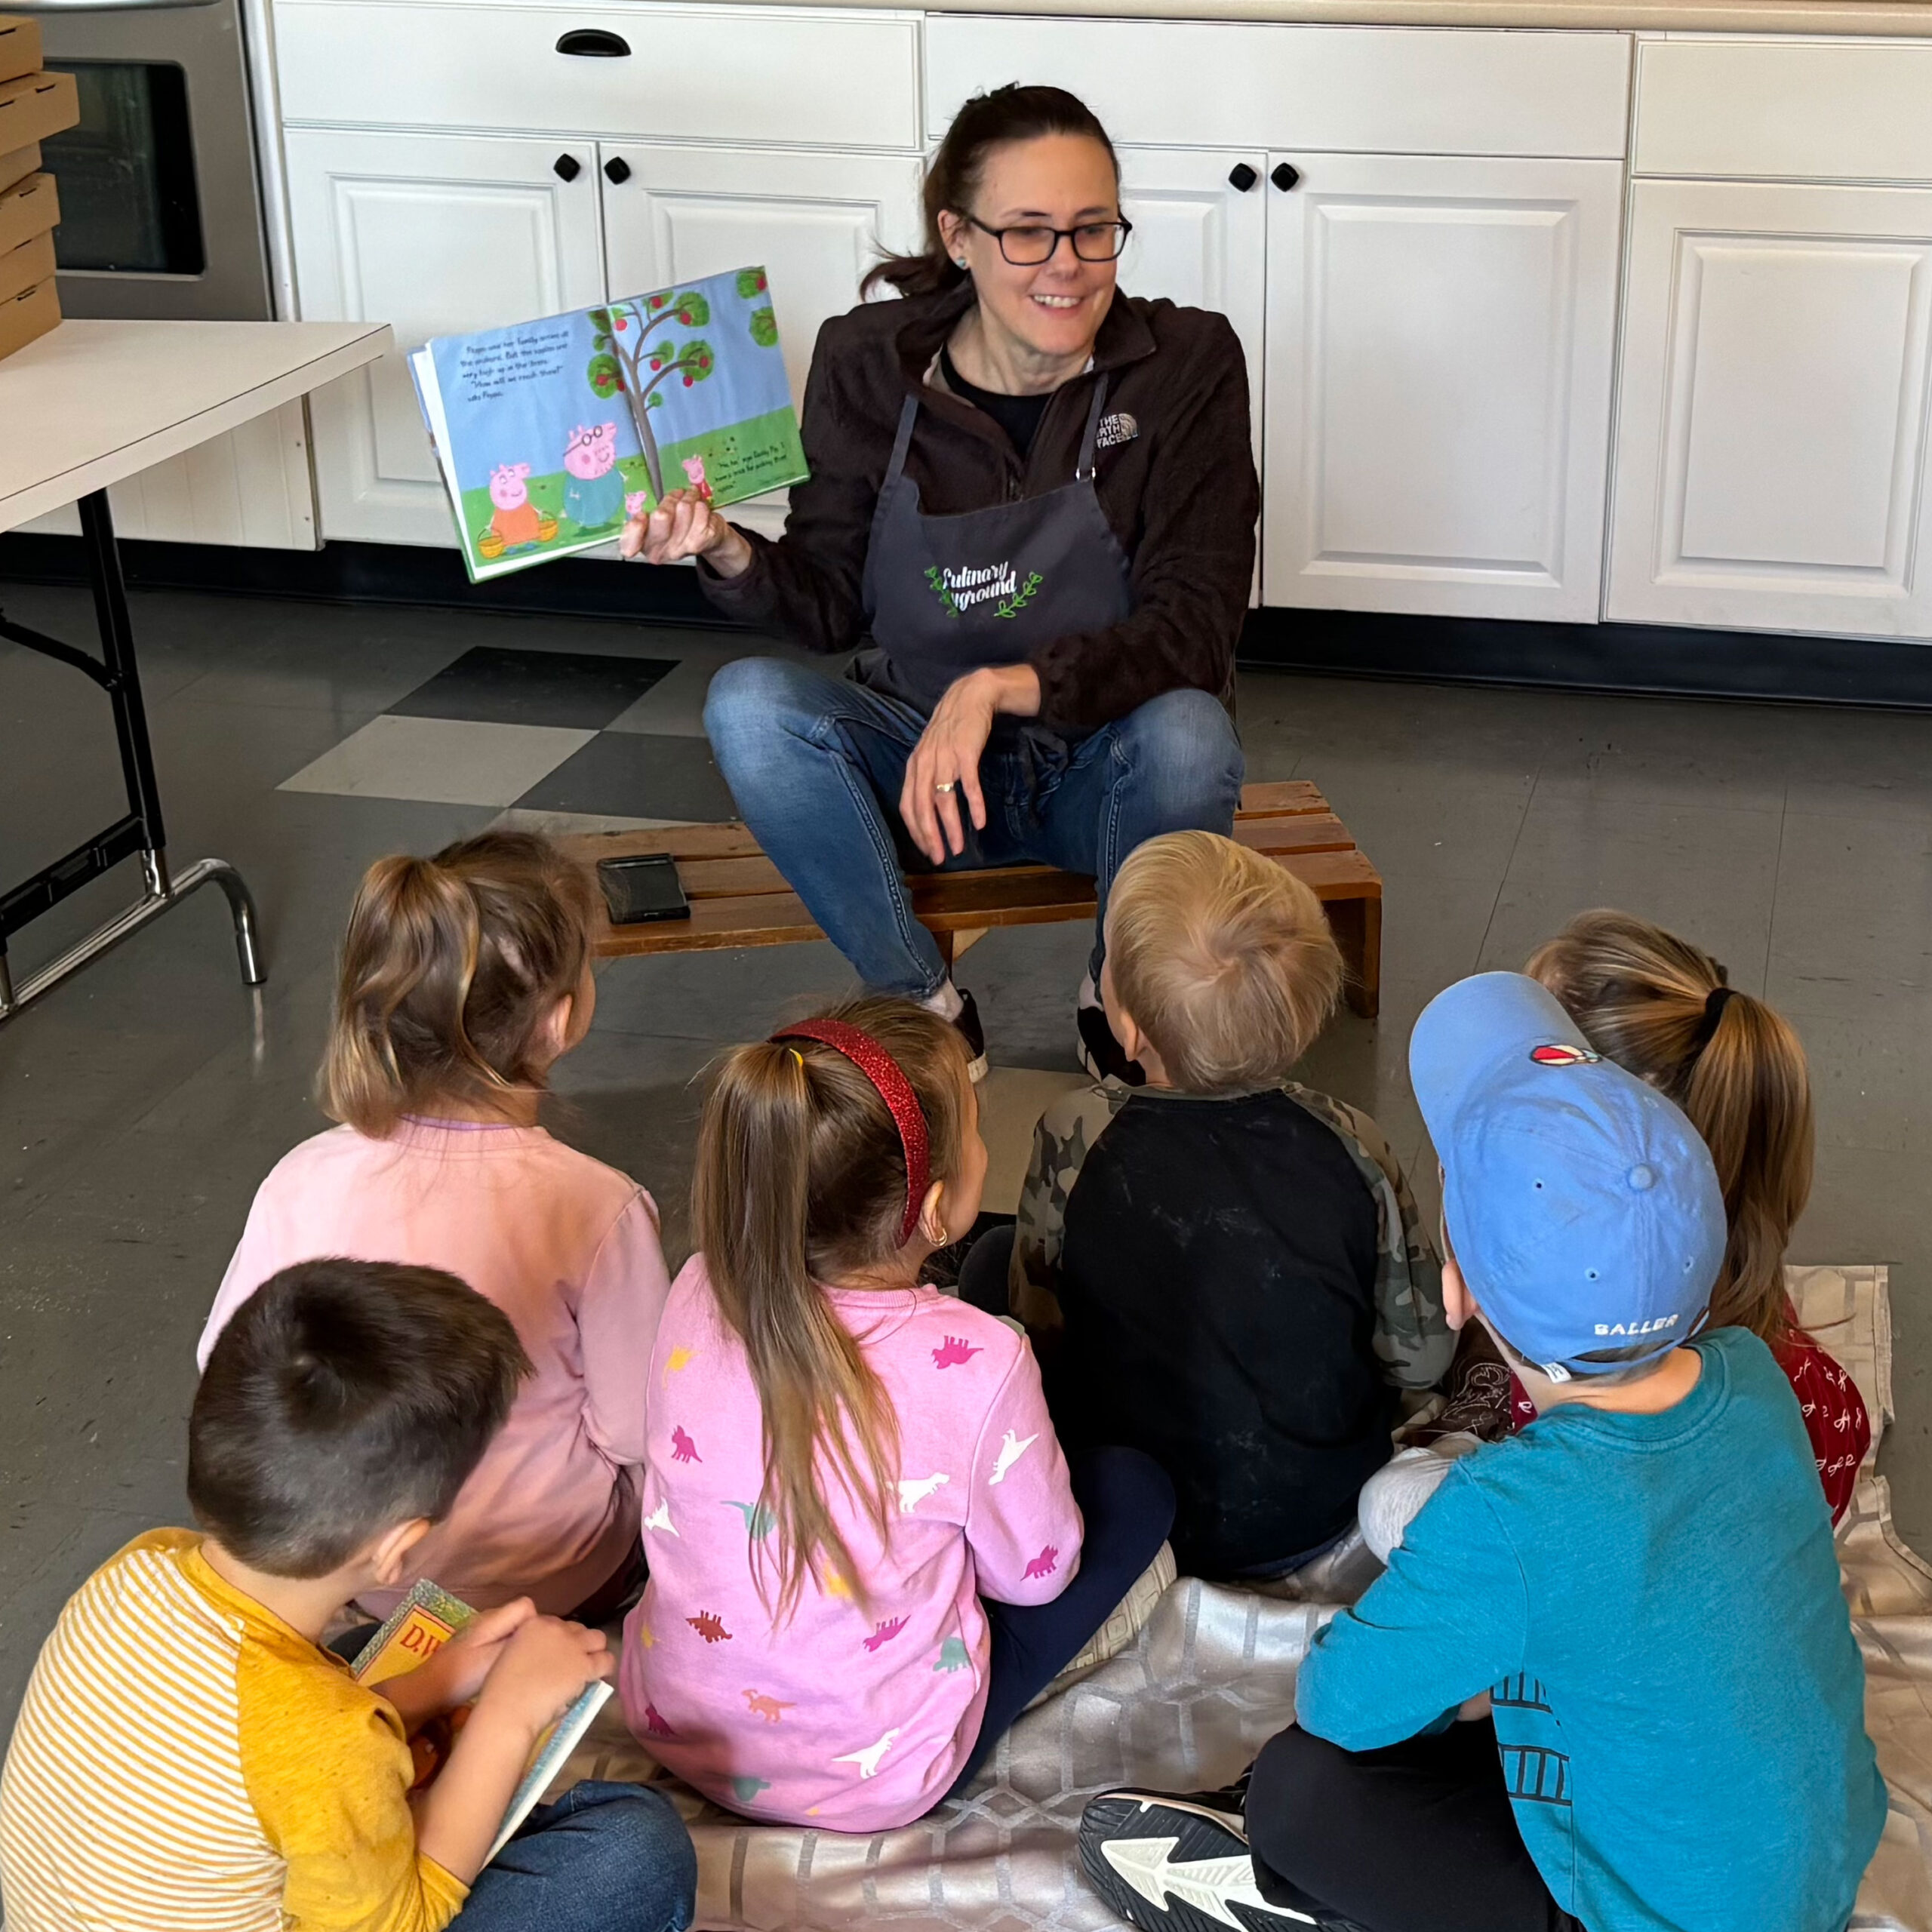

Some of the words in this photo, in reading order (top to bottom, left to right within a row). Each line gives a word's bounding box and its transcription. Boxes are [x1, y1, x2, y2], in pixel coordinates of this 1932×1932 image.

[1100, 414, 1119, 427] THE
[1097, 423, 1121, 437] RTH
[1097, 433, 1123, 448] FACE
[1594, 1314, 1678, 1336] BALLER
